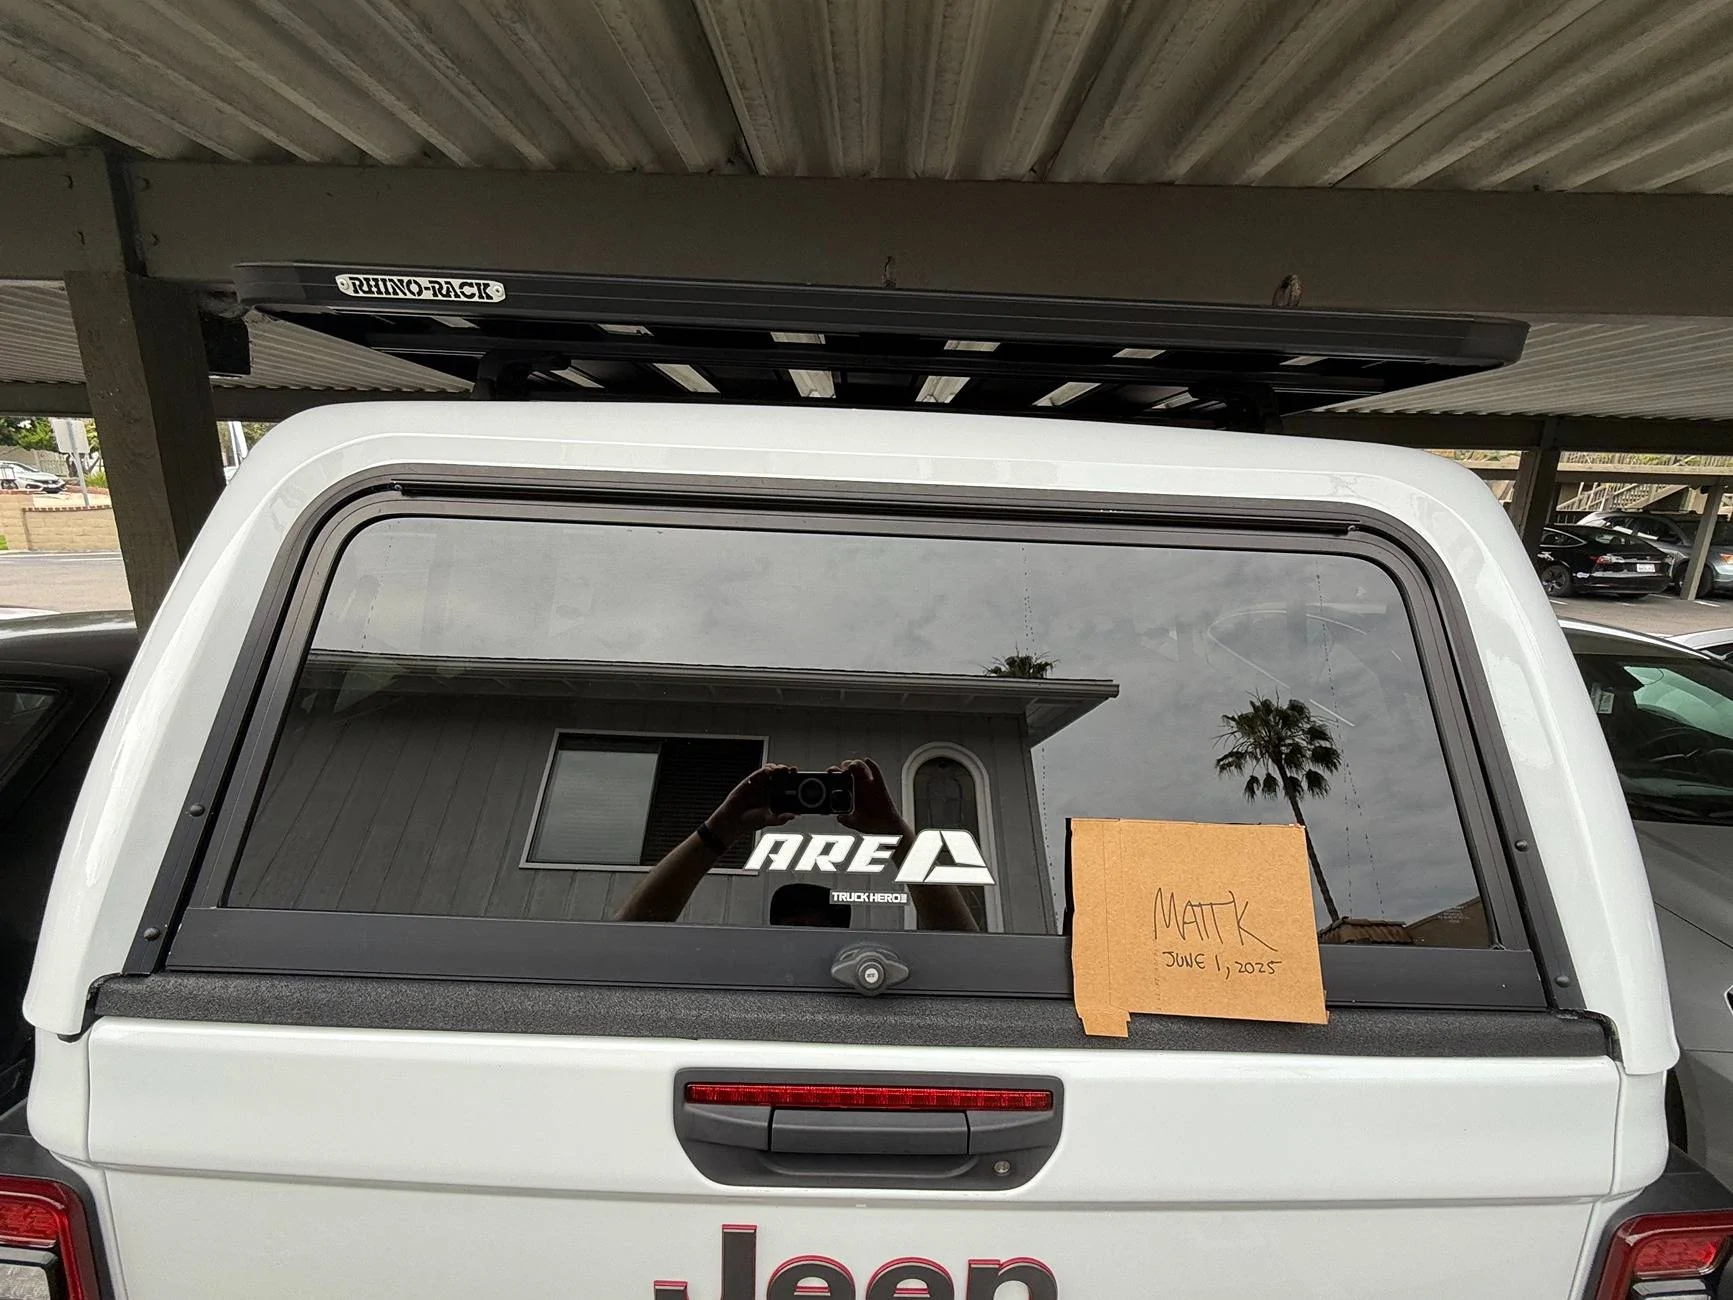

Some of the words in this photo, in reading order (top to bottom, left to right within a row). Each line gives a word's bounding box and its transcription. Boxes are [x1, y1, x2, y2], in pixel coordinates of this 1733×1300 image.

[348, 276, 494, 301] RHINO-RACK
[832, 891, 869, 902] TRUCK
[1162, 951, 1206, 970] JUNE
